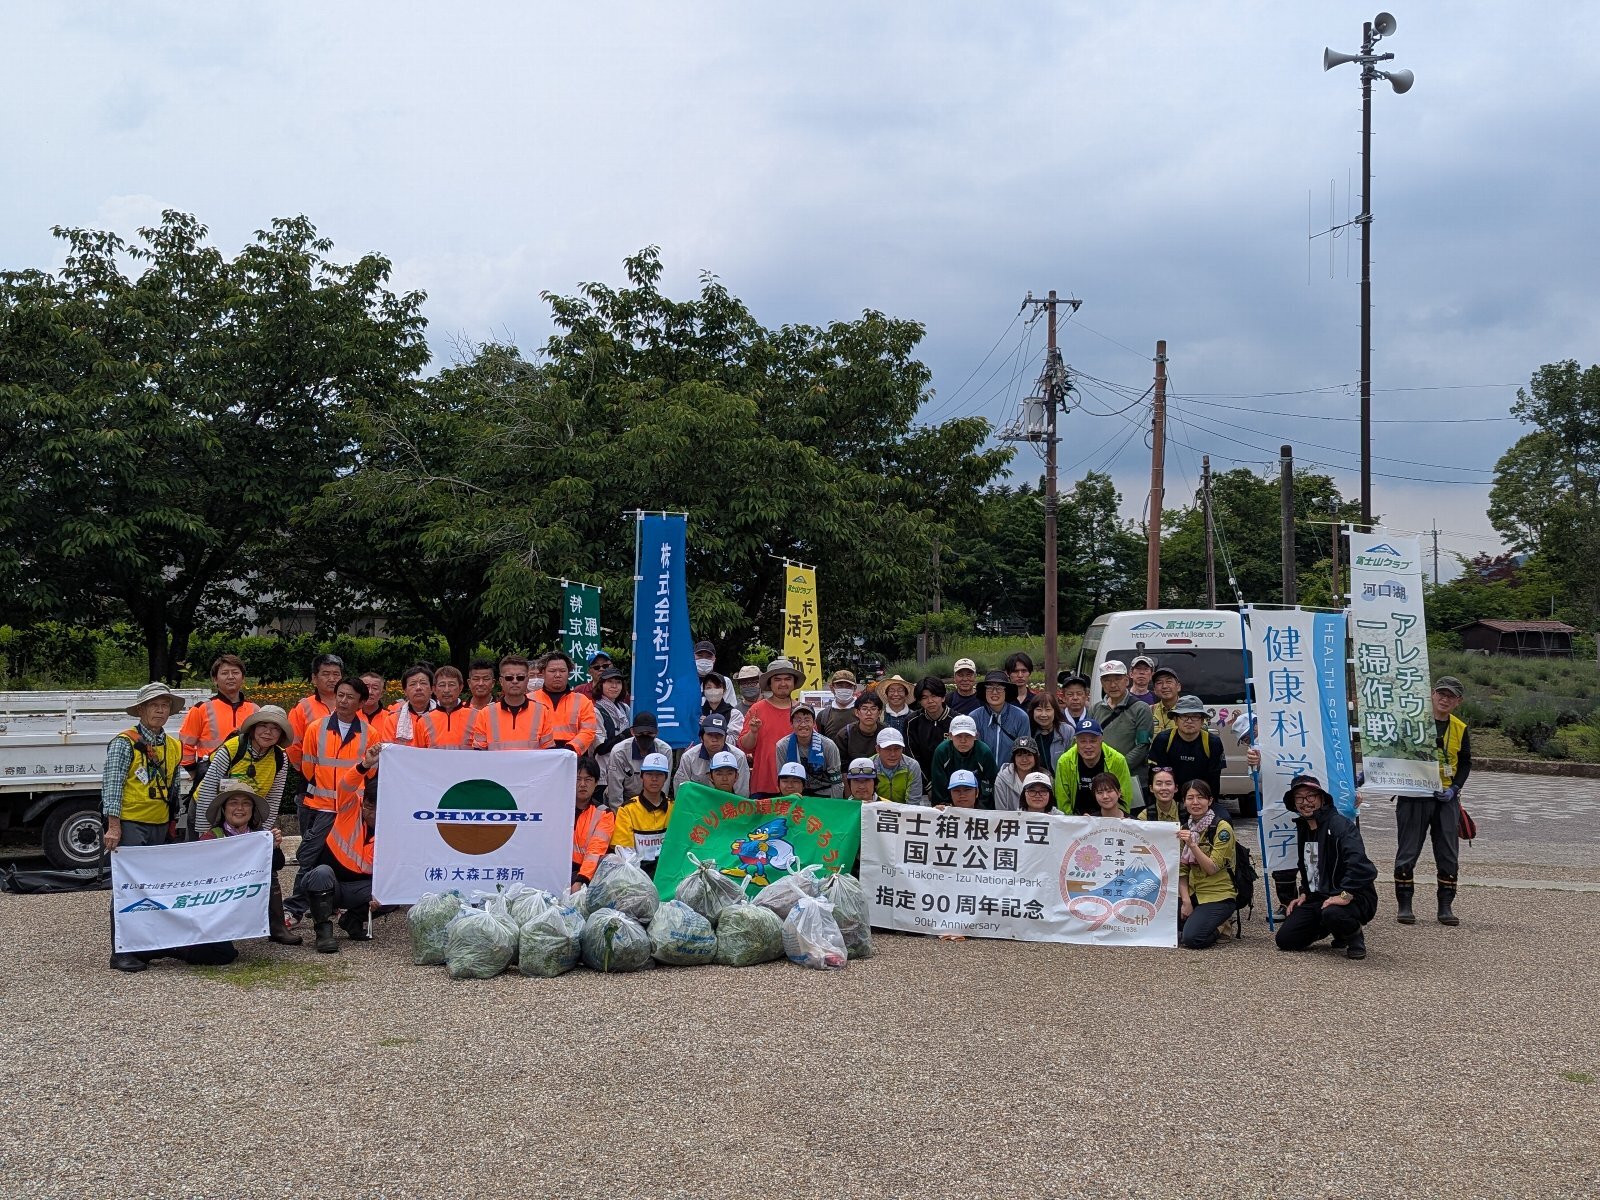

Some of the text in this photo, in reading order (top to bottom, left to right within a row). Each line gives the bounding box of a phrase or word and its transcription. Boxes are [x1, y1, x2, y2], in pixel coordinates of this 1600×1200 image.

[1355, 555, 1413, 570] 富士山クラブ
[1363, 582, 1407, 600] 河口湖
[1165, 620, 1226, 630] 富士山クラブ
[1324, 623, 1335, 689] HEALTH
[1356, 618, 1399, 743] 一掃作戦
[1391, 611, 1427, 747] アレチウリ
[1327, 698, 1346, 772] SCIENCE
[4, 764, 97, 776] 寄贈 社団法人
[413, 810, 543, 822] OHMORI
[876, 808, 1051, 846] 富士箱根伊豆
[903, 840, 1018, 873] 国立公園
[1102, 837, 1115, 897] 国立公園
[1113, 838, 1126, 898] 富士箱根伊豆
[881, 864, 898, 877] Fuji
[908, 869, 944, 882] Hakone
[955, 872, 971, 884] Izu
[975, 874, 1017, 887] National
[1019, 877, 1043, 889] Park
[171, 882, 268, 910] 富士山クラブ
[875, 884, 1045, 920] 指定90周年記念
[914, 916, 1001, 933] 90th Anniversary
[1102, 924, 1122, 932] SINCE
